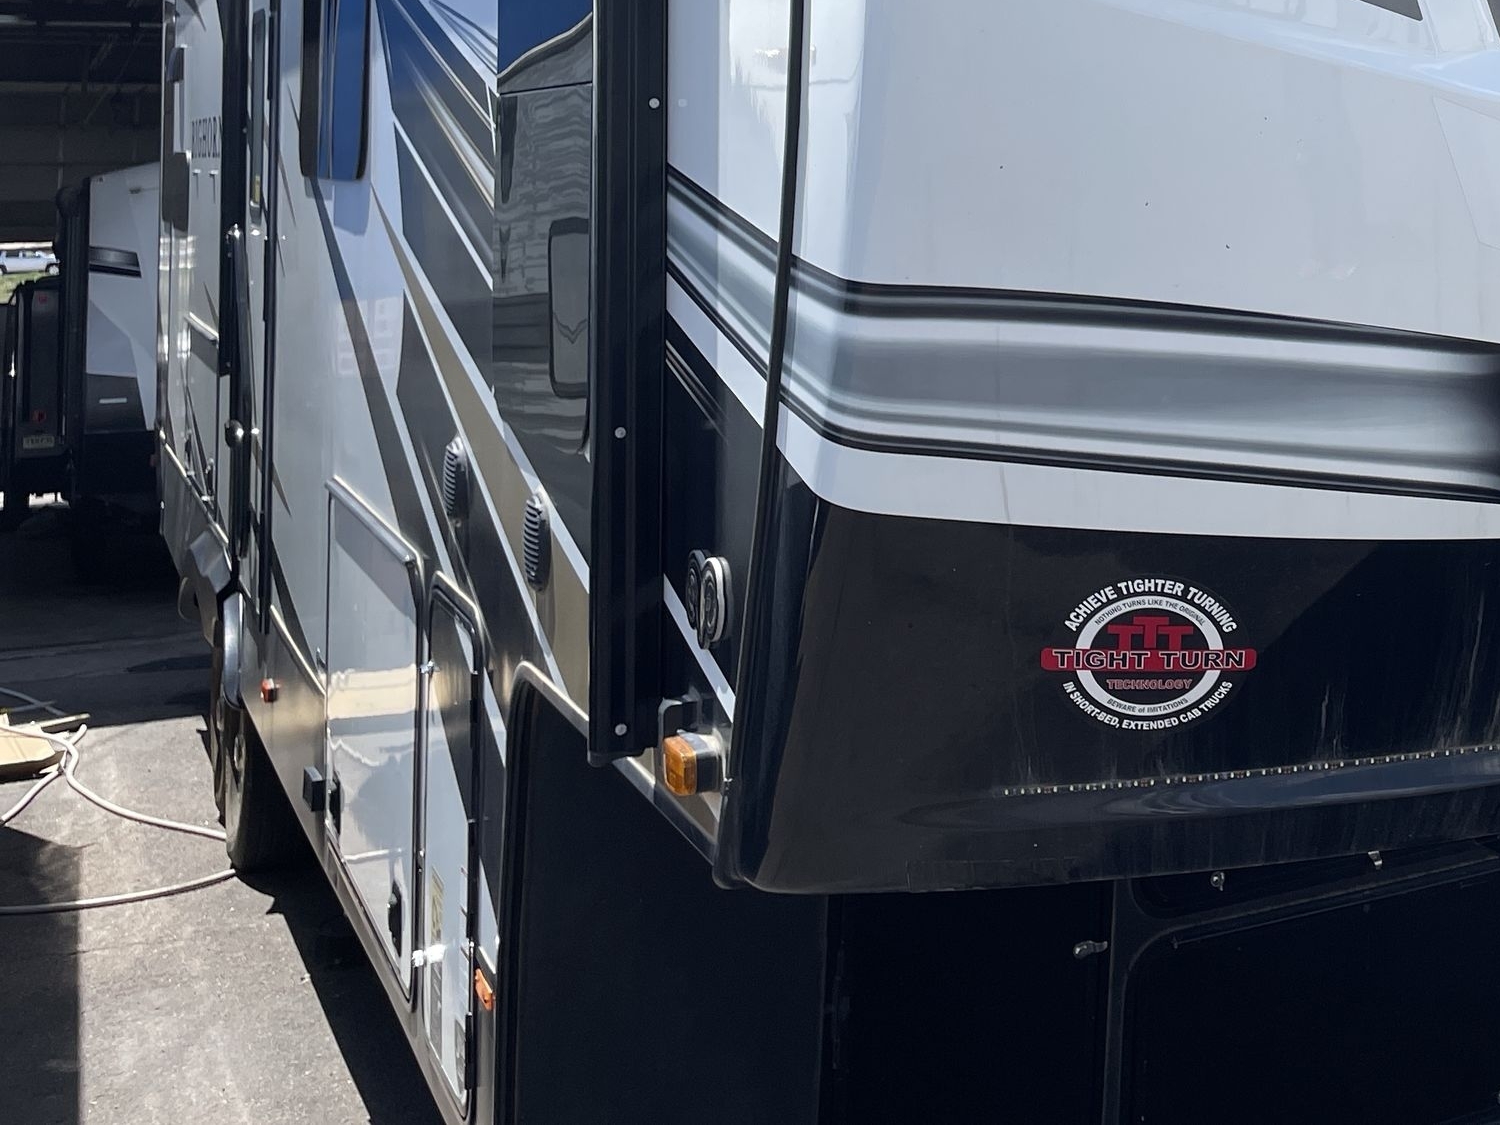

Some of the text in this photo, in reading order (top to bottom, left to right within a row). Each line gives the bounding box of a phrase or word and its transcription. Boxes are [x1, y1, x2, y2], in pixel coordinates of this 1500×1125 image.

[1064, 578, 1237, 633] ACHIEVE TIGHTER TURNING
[1094, 605, 1122, 625] NOTHING
[1122, 598, 1147, 610] TURNS
[1147, 598, 1163, 607] LIKE
[1165, 601, 1179, 610] THE
[1052, 649, 1246, 669] TIGHT TURN
[1106, 678, 1193, 690] TECHNOLOGY
[1062, 681, 1233, 730] IN SHORT-BED, EXTENDED CAB TRUCKS
[1106, 698, 1137, 713] BEWARE
[1147, 697, 1189, 713] IMITATIONS
